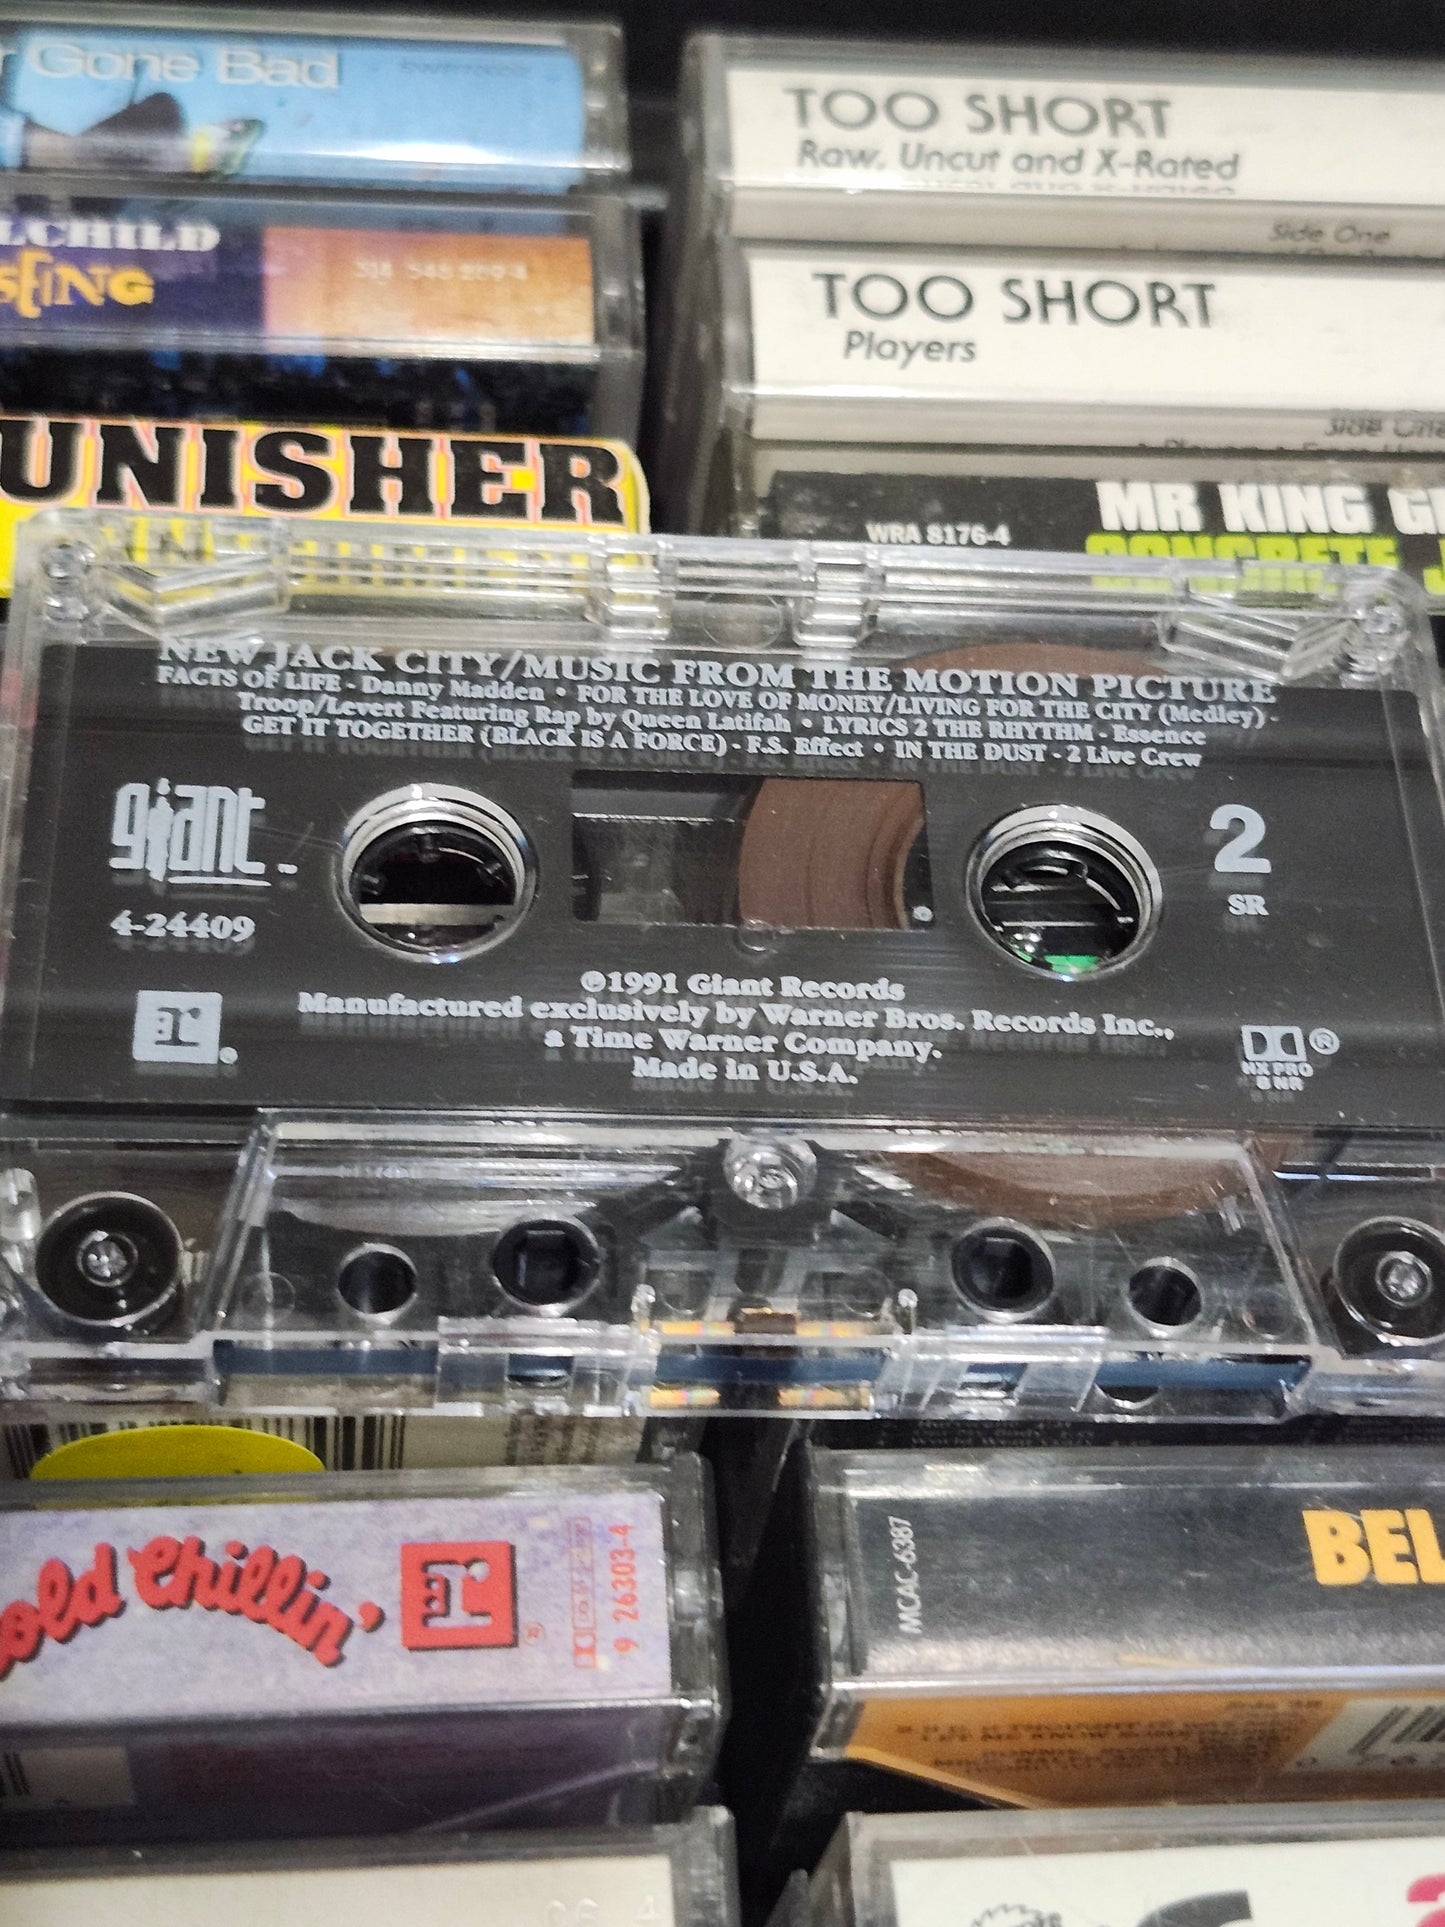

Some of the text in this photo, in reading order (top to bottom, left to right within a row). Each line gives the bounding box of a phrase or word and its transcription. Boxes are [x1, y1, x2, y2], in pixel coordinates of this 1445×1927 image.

[27, 42, 201, 83] Gone
[216, 46, 340, 90] Bad
[784, 88, 1172, 139] TOO SHORT
[900, 142, 1001, 172] Uncut
[1012, 148, 1084, 175] and
[1093, 149, 1242, 182] X-Rated
[811, 272, 1218, 329] TOO SHORT
[843, 330, 977, 371] Players
[0, 419, 626, 526] UNISHER
[1096, 480, 1205, 533] MR
[1217, 482, 1375, 535] KING
[865, 521, 1012, 547] WRA 8176-4
[157, 637, 1277, 705] NEW JACK CITY/MUSIC FROM THE MOTION PICTURE
[156, 665, 1268, 730] FACTS OF LIFE Danny Madden FOR THE LOVE OF MONEY/LIVING FOR THE CITY (Medley)
[236, 691, 1208, 746] Troop/Levert Featuring Rap by Queen Latifah LYRICS 2 THE RHYTHM Essence
[240, 714, 1204, 768] GET IT TOGETHER (BLACK IS A FORCE) F.S. Effect IN THE DUST 2 Live Crew
[1209, 803, 1273, 875] 2
[110, 909, 257, 943] 4-24409
[1227, 893, 1270, 916] SR
[686, 973, 775, 997] Giant
[779, 975, 907, 1001] Records
[297, 991, 1177, 1041] Manufactured exclusively by Warner Bros. Records Inc.,
[543, 1025, 944, 1065] a Time Warner Company.
[631, 1055, 860, 1085] Made in U.S.A.
[607, 1524, 640, 1655] 9 26303-4
[887, 1515, 923, 1635] MCAC-6387
